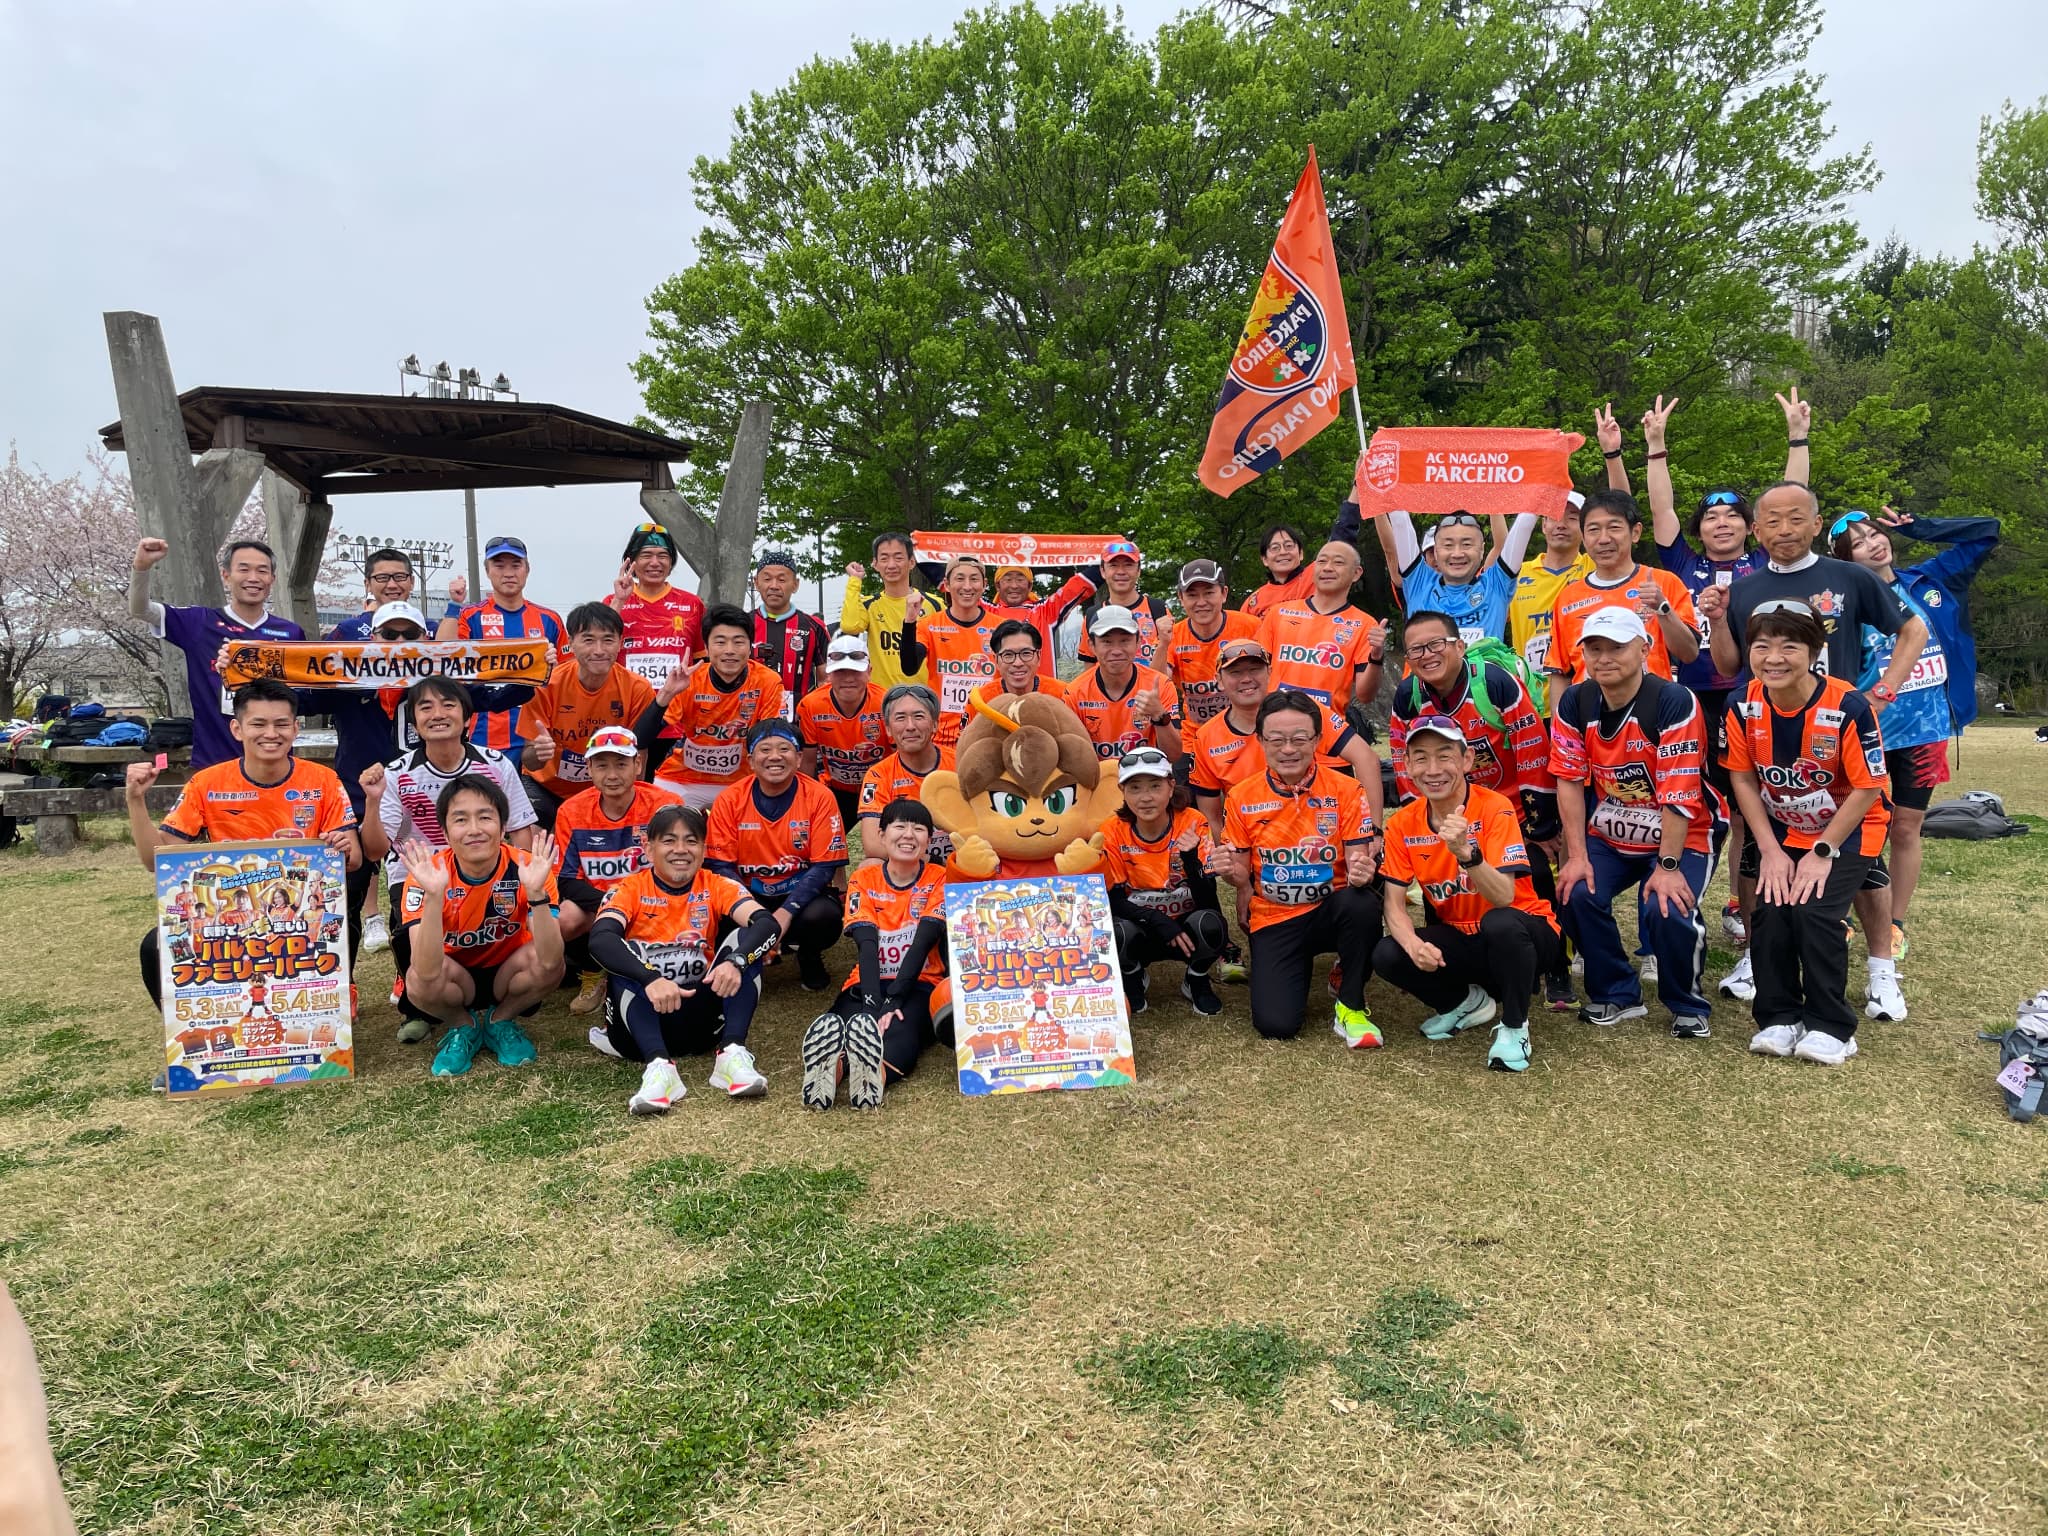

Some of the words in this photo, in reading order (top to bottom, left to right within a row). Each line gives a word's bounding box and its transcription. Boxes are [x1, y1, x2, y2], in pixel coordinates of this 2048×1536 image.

[1425, 453, 1445, 464] AC
[1449, 453, 1508, 464] NAGANO
[1425, 465, 1525, 484] PARCEIRO
[646, 636, 687, 648] YARIS
[306, 656, 336, 678] AC
[343, 656, 433, 681] NAGANO
[441, 652, 534, 677] PARCEIRO
[937, 654, 995, 676] HOKTO
[1279, 642, 1345, 670] HOKTO
[695, 754, 740, 768] 6630
[820, 743, 885, 762] HOKTO
[1605, 820, 1662, 844] 10779
[1258, 835, 1337, 866] HOKTO
[176, 996, 215, 1020] 5.3
[215, 1000, 241, 1014] SAT
[272, 990, 311, 1013] 5.4
[311, 991, 340, 1006] SUN
[965, 1001, 1001, 1025] 5.3
[1052, 995, 1089, 1018] 5.4
[215, 1034, 227, 1044] 12
